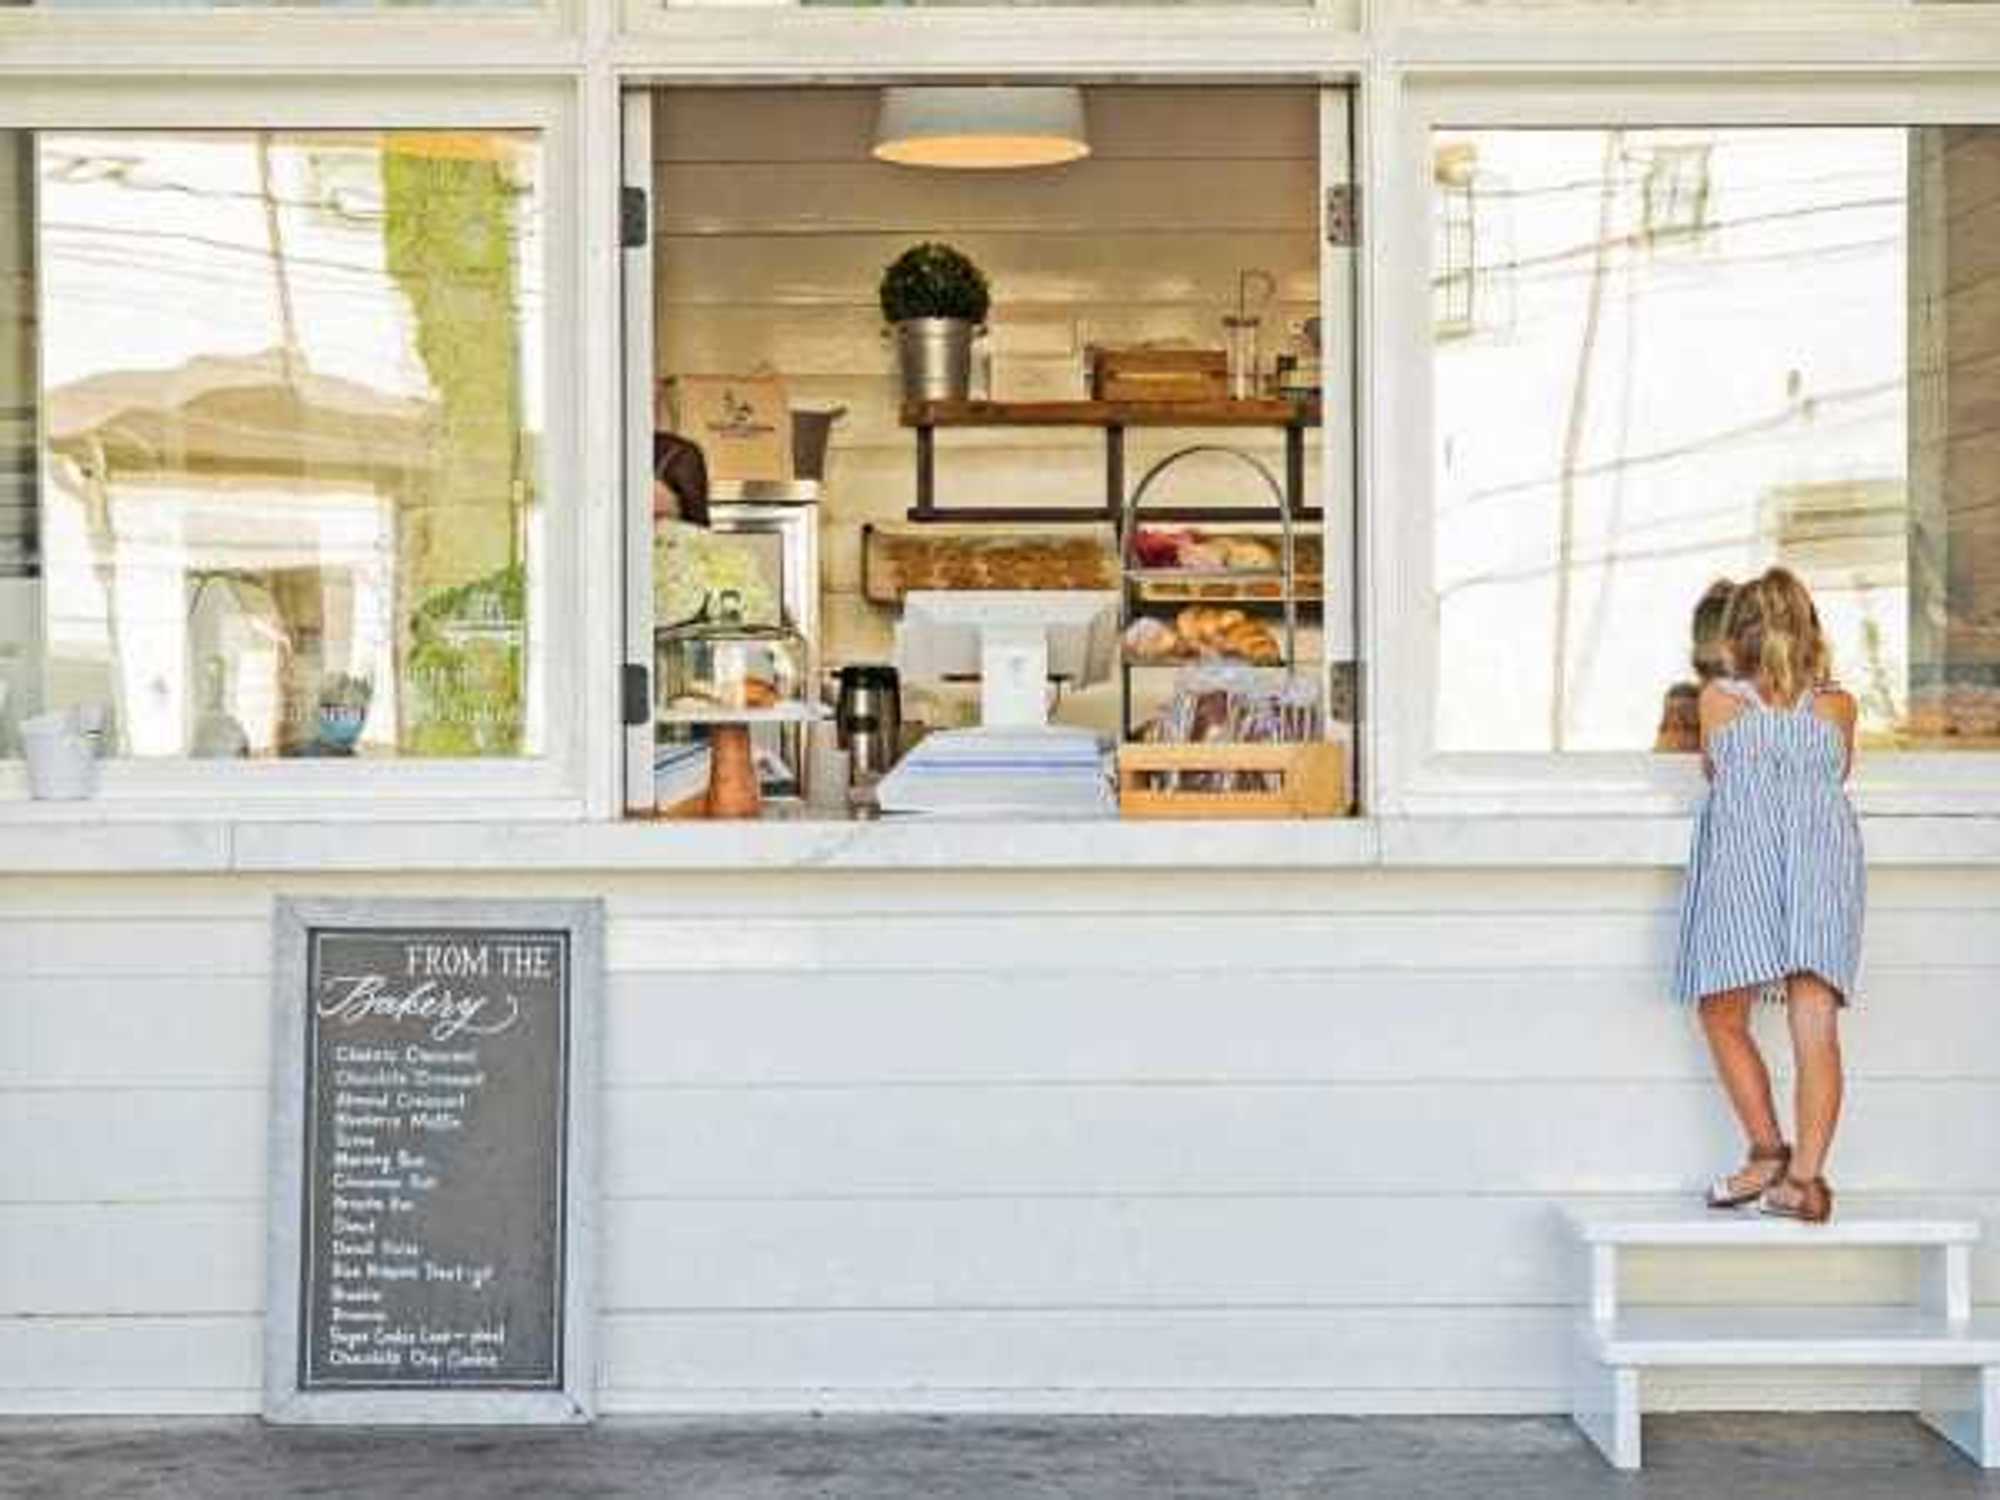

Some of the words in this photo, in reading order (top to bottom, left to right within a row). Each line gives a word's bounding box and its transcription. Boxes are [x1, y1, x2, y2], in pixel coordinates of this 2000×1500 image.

[404, 944, 488, 976] FROM
[497, 945, 551, 977] THE
[318, 975, 518, 1039] Bakery
